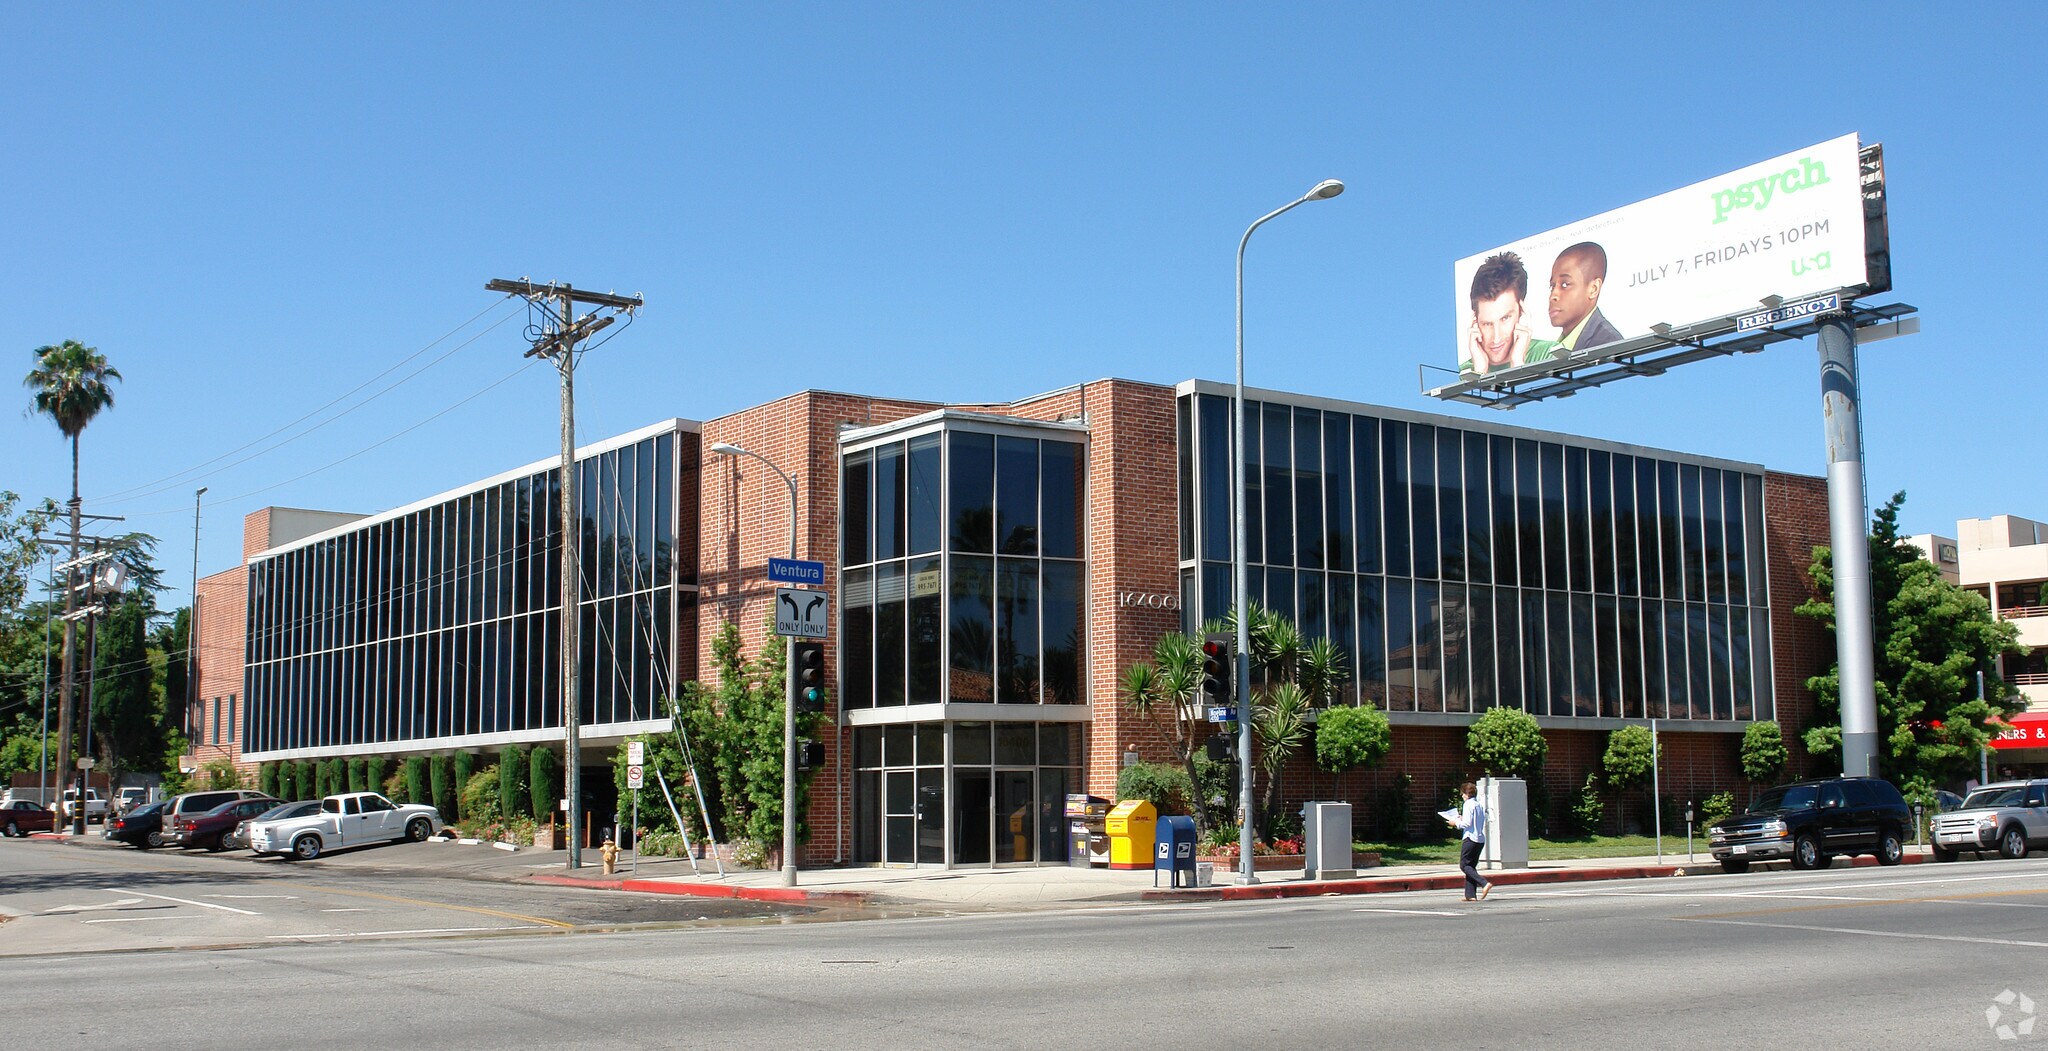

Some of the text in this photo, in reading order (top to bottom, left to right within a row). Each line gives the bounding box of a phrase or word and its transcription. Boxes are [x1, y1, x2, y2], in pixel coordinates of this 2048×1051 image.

[1711, 156, 1831, 224] psych
[1628, 263, 1669, 288] JULY
[1675, 259, 1688, 275] 7,
[1694, 235, 1773, 270] FRIDAYS
[1779, 218, 1830, 245] 10PM
[1740, 297, 1834, 329] REGENCY
[773, 563, 819, 579] Ventura
[1120, 592, 1177, 610] 16400
[779, 621, 824, 634] ONLY ONLY
[2036, 728, 2046, 739] &
